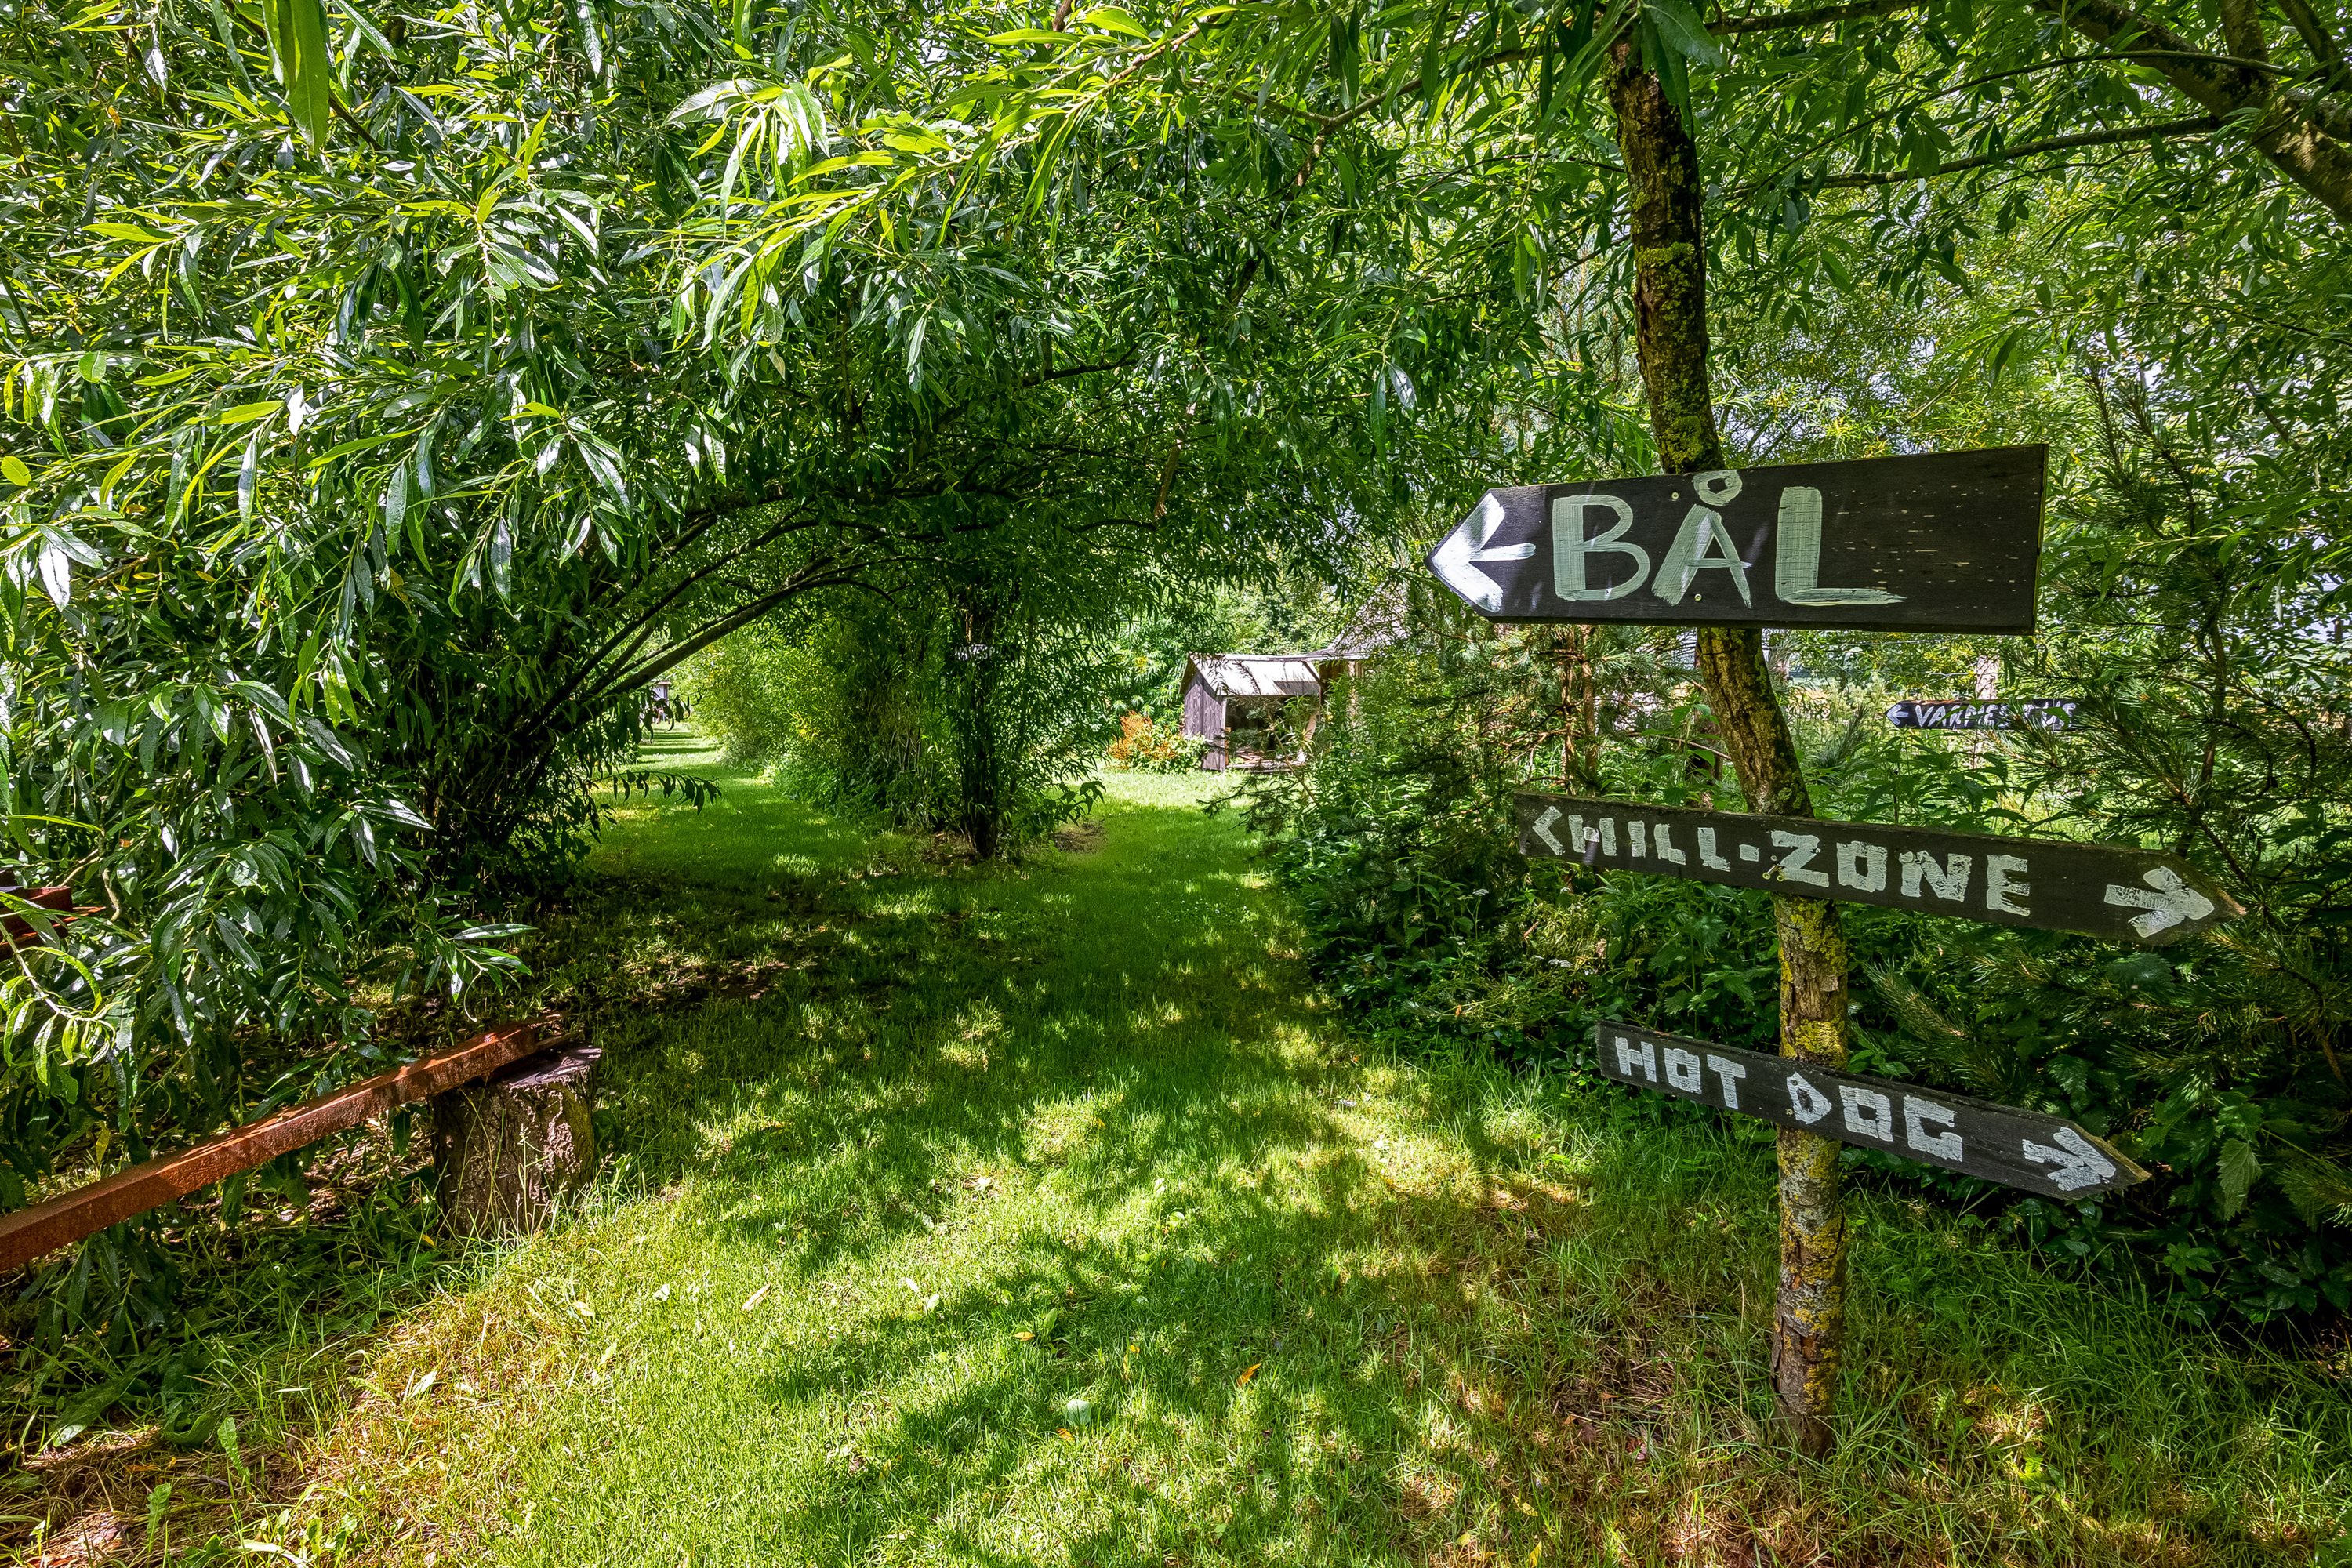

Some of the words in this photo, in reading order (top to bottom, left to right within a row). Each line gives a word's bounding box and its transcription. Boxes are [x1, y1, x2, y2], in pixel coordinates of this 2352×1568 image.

[1552, 470, 1907, 608] BÅL
[1532, 805, 2031, 916] CHILL-ZONE
[1615, 1036, 1746, 1109] HOT
[1787, 1072, 1963, 1161] DOG
